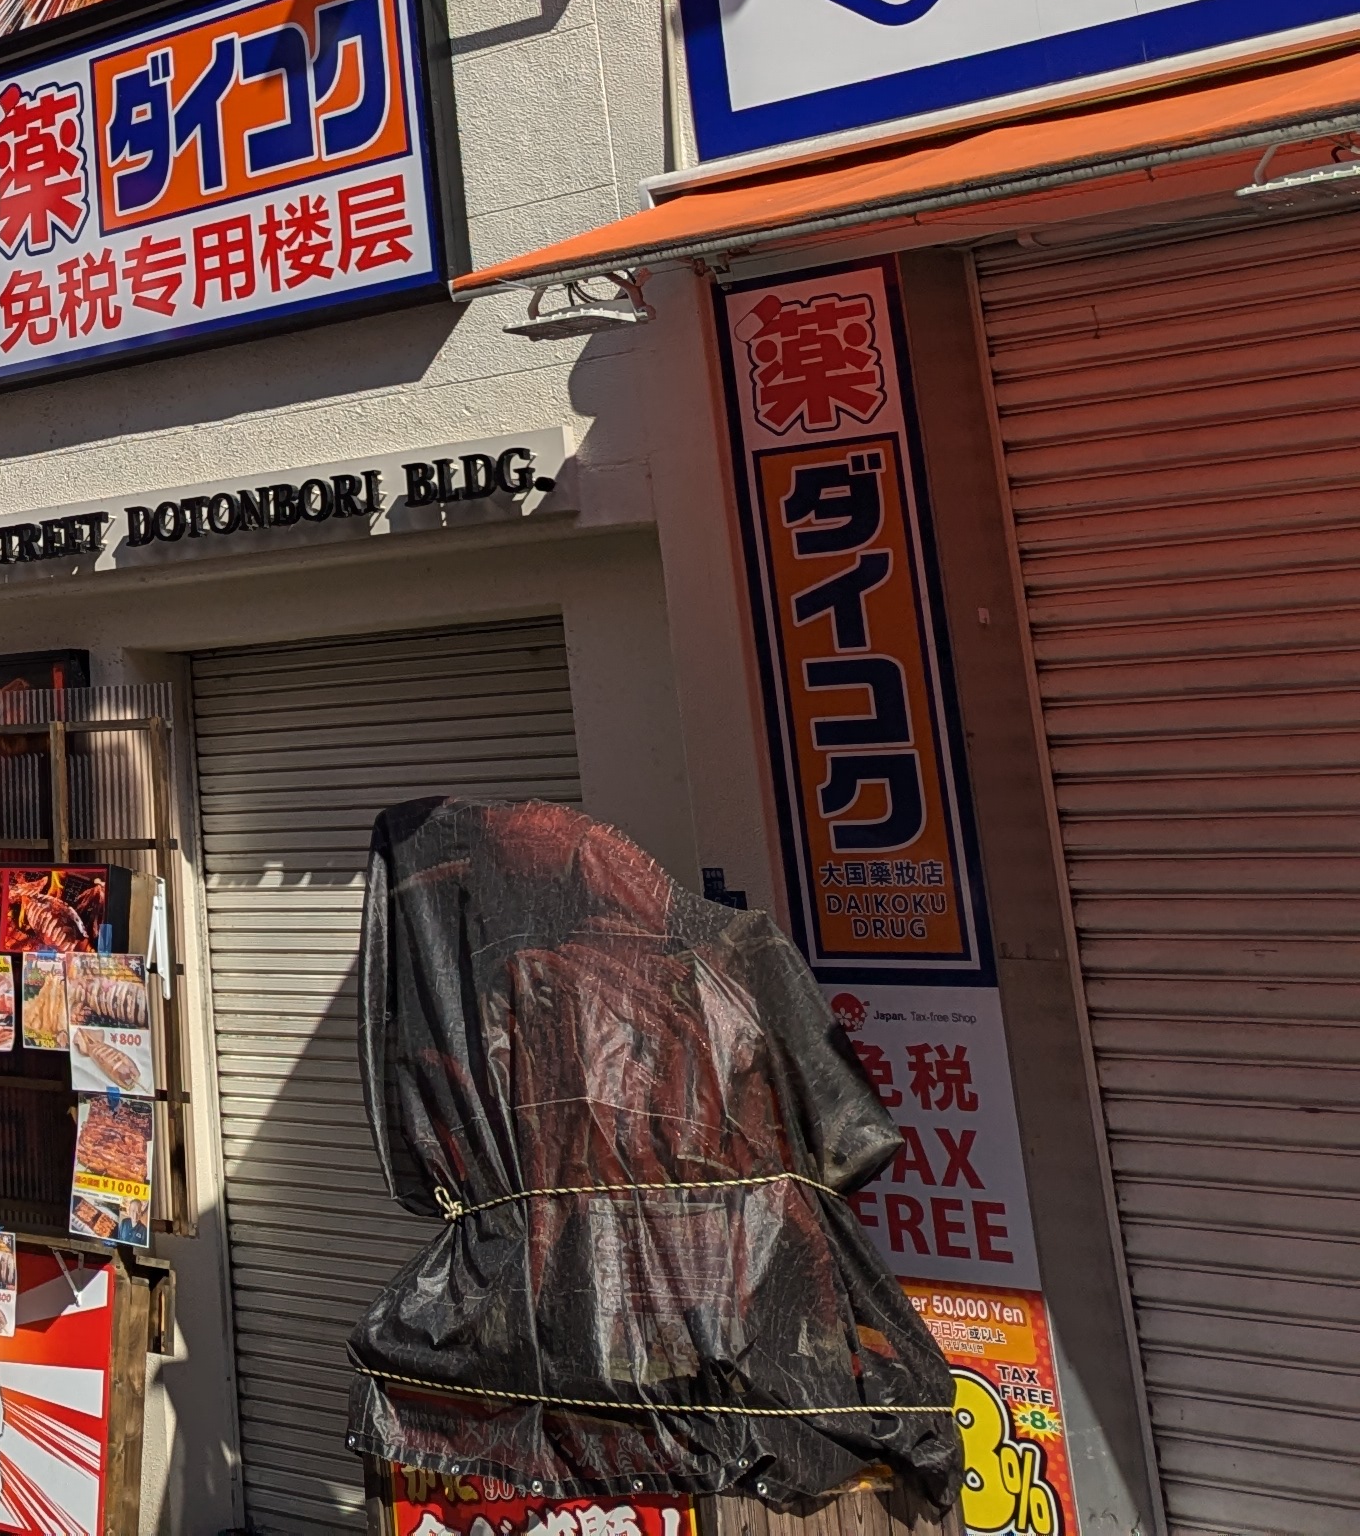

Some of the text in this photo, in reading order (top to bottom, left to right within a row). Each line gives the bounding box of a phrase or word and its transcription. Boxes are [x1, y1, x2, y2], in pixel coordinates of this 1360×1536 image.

[736, 296, 886, 434] 薬
[124, 469, 385, 548] DOTONBORI
[401, 446, 557, 509] BLDG.
[782, 450, 926, 853] ダイコク
[820, 862, 946, 888] 大国藥妝店
[826, 892, 948, 917] DAIKOKU
[851, 916, 928, 942] DRUG
[873, 1009, 978, 1026] Japan. Tax-free Shop
[109, 1031, 143, 1047] ¥800
[879, 1125, 987, 1190] AX
[932, 1293, 1024, 1327] 50,000 Yen
[997, 1364, 1040, 1386] TAX
[999, 1384, 1055, 1407] FREE
